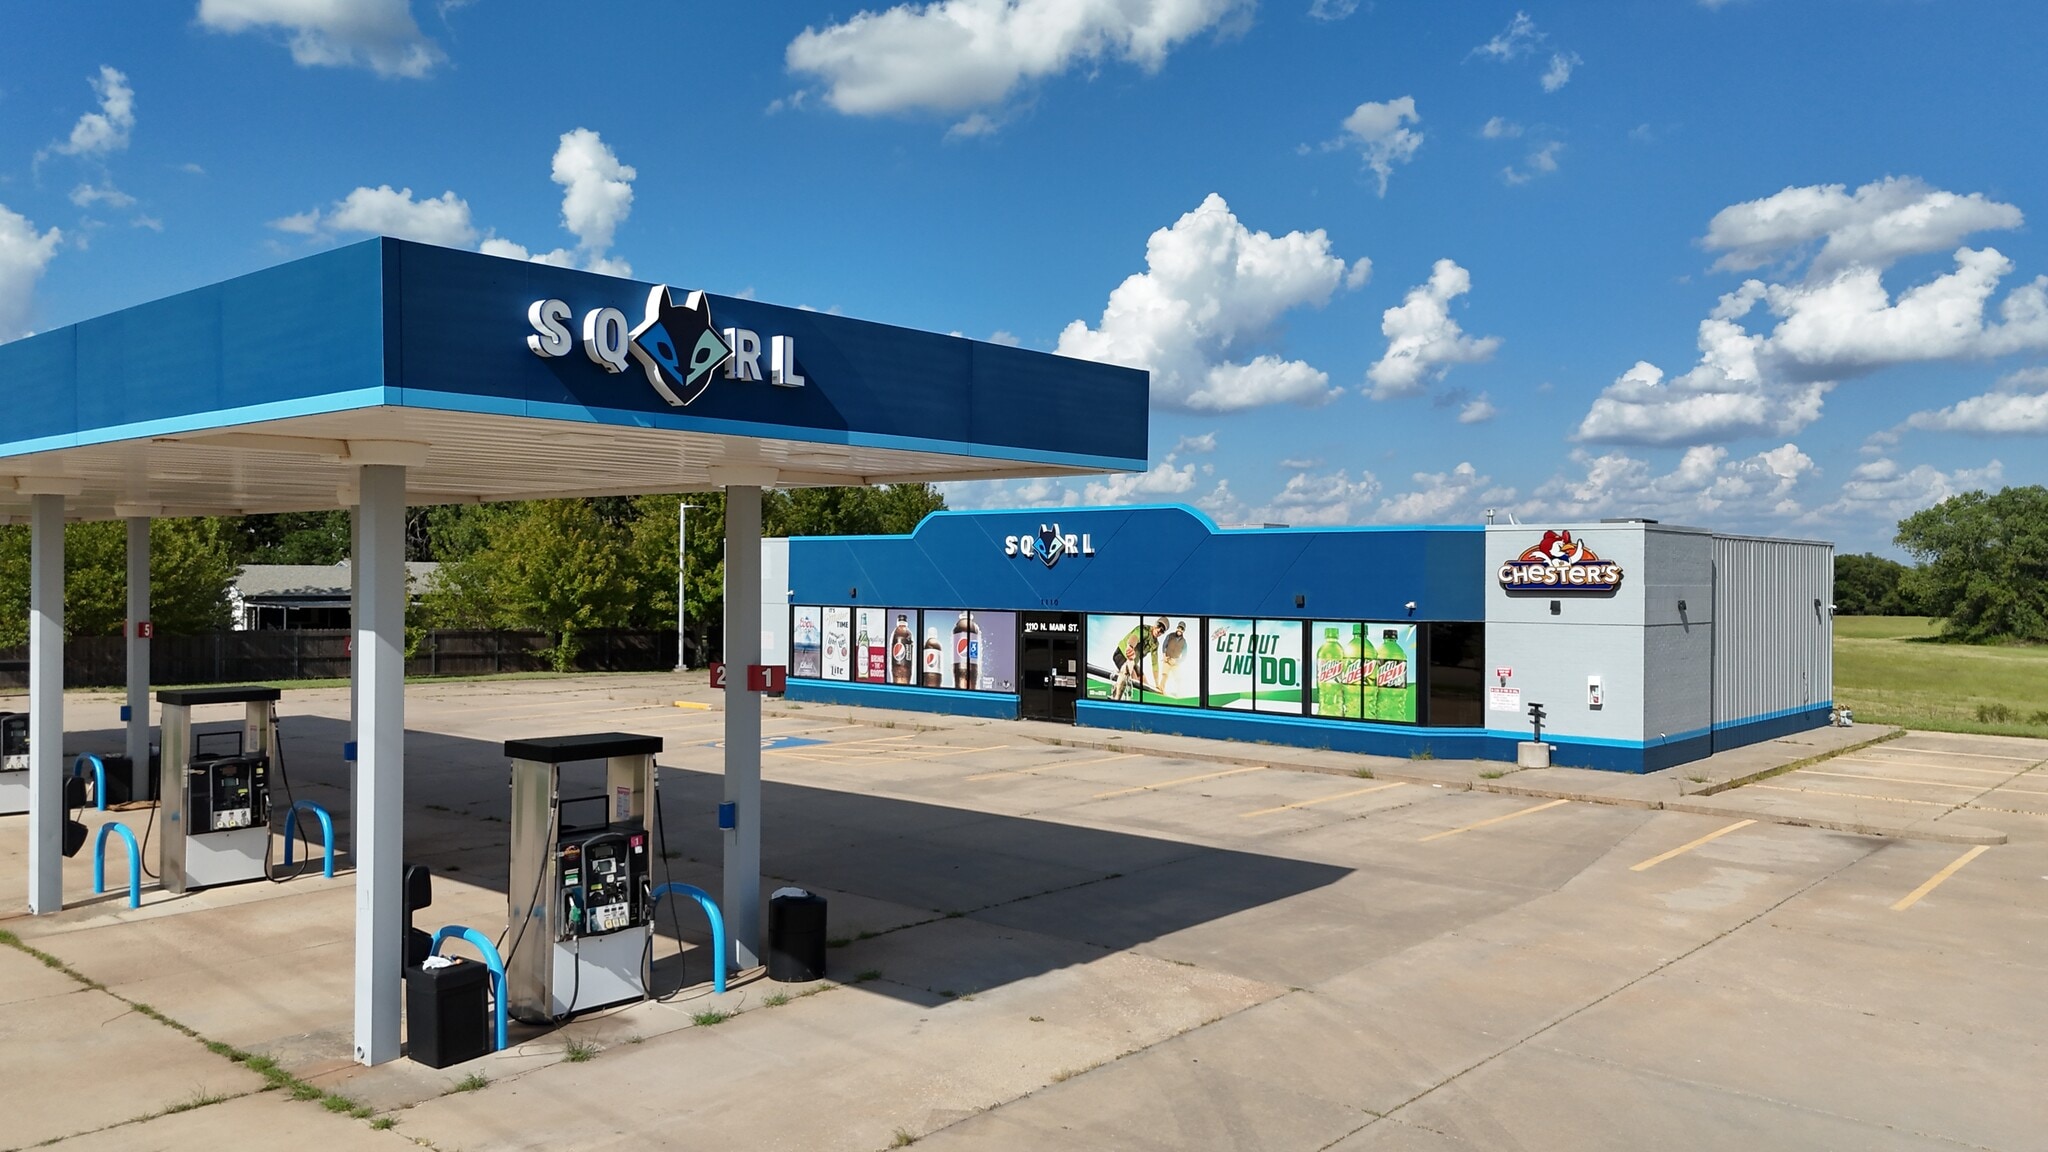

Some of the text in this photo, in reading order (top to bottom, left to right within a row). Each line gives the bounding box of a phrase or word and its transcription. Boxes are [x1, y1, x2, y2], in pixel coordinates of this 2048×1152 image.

[144, 624, 150, 636] 5
[836, 621, 848, 629] TIME
[1049, 623, 1066, 632] MAIN
[1068, 623, 1079, 632] ST.
[1216, 633, 1245, 653] GET
[1247, 634, 1280, 655] OUT
[1222, 654, 1254, 675] AND
[716, 666, 727, 685] 2
[762, 667, 772, 687] 1
